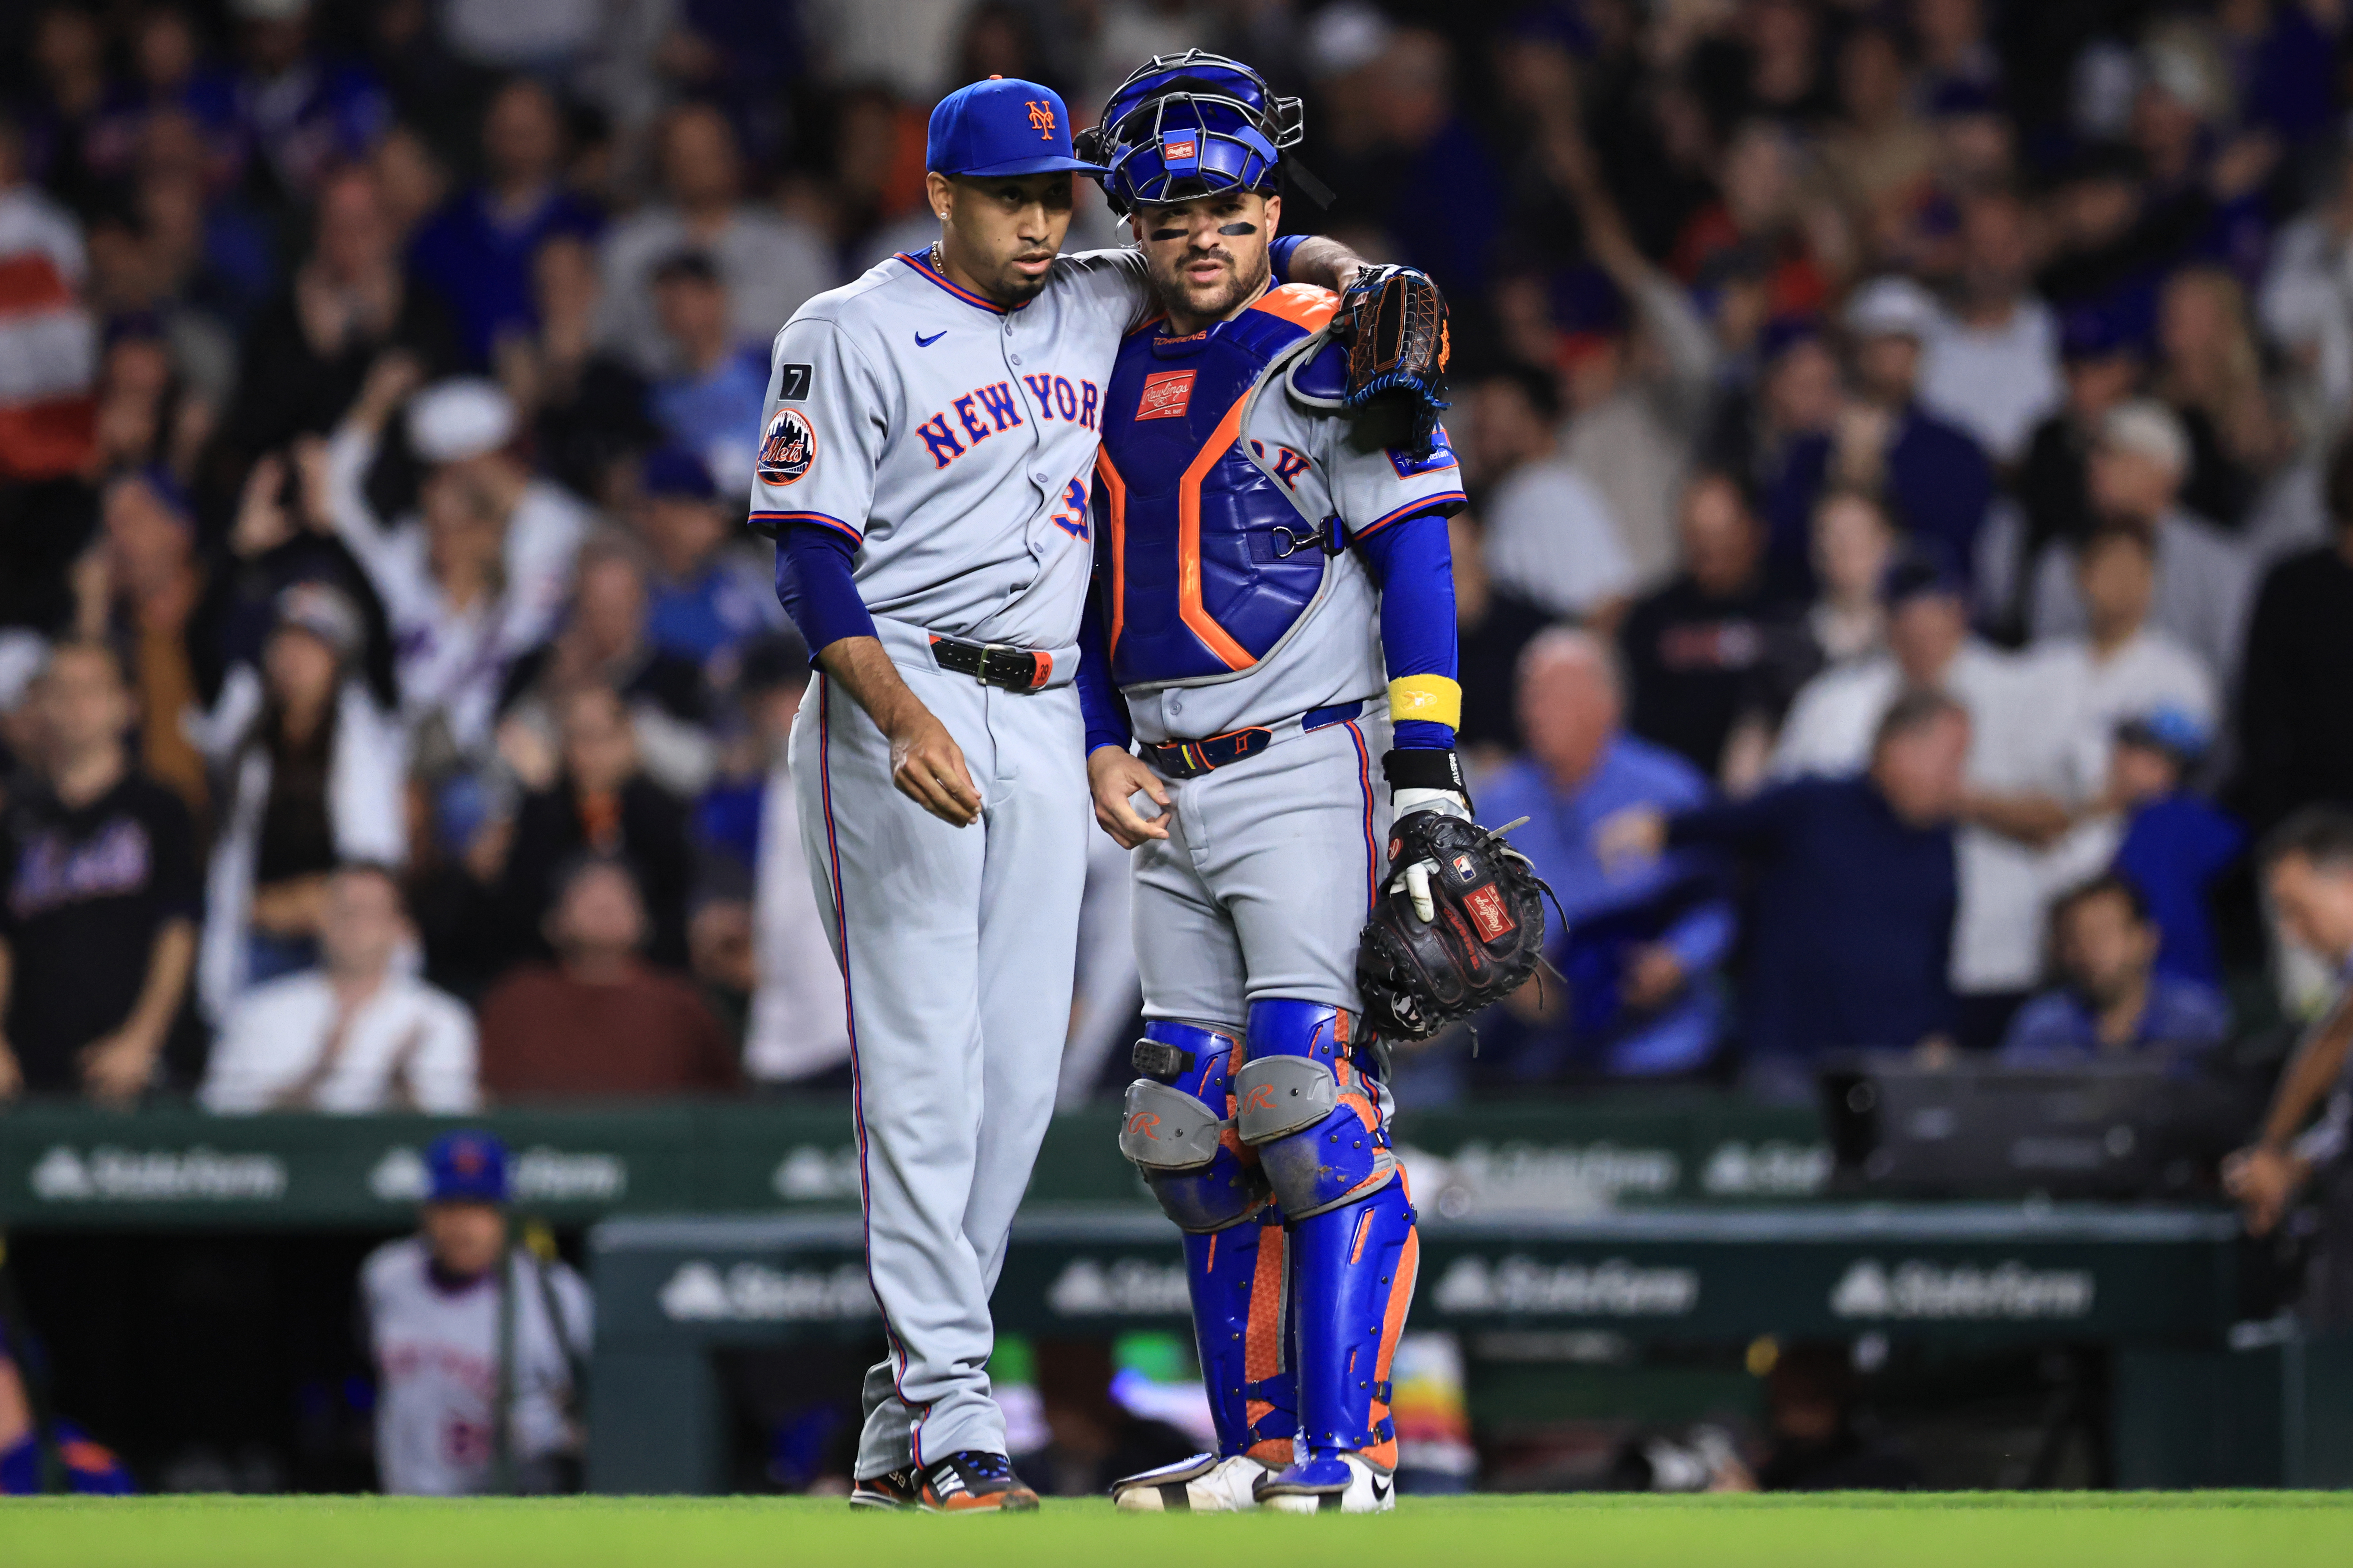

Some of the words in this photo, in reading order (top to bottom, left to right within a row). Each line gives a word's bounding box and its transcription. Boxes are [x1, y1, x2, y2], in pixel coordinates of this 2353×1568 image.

[1025, 101, 1055, 140] NY
[1153, 331, 1207, 346] TORRENS
[790, 369, 802, 396] 7
[1141, 382, 1188, 405] Rawlings
[915, 381, 1023, 470] NEW
[1022, 373, 1108, 438] YOR
[761, 436, 804, 462] Mets
[1474, 896, 1503, 931] Rawlings
